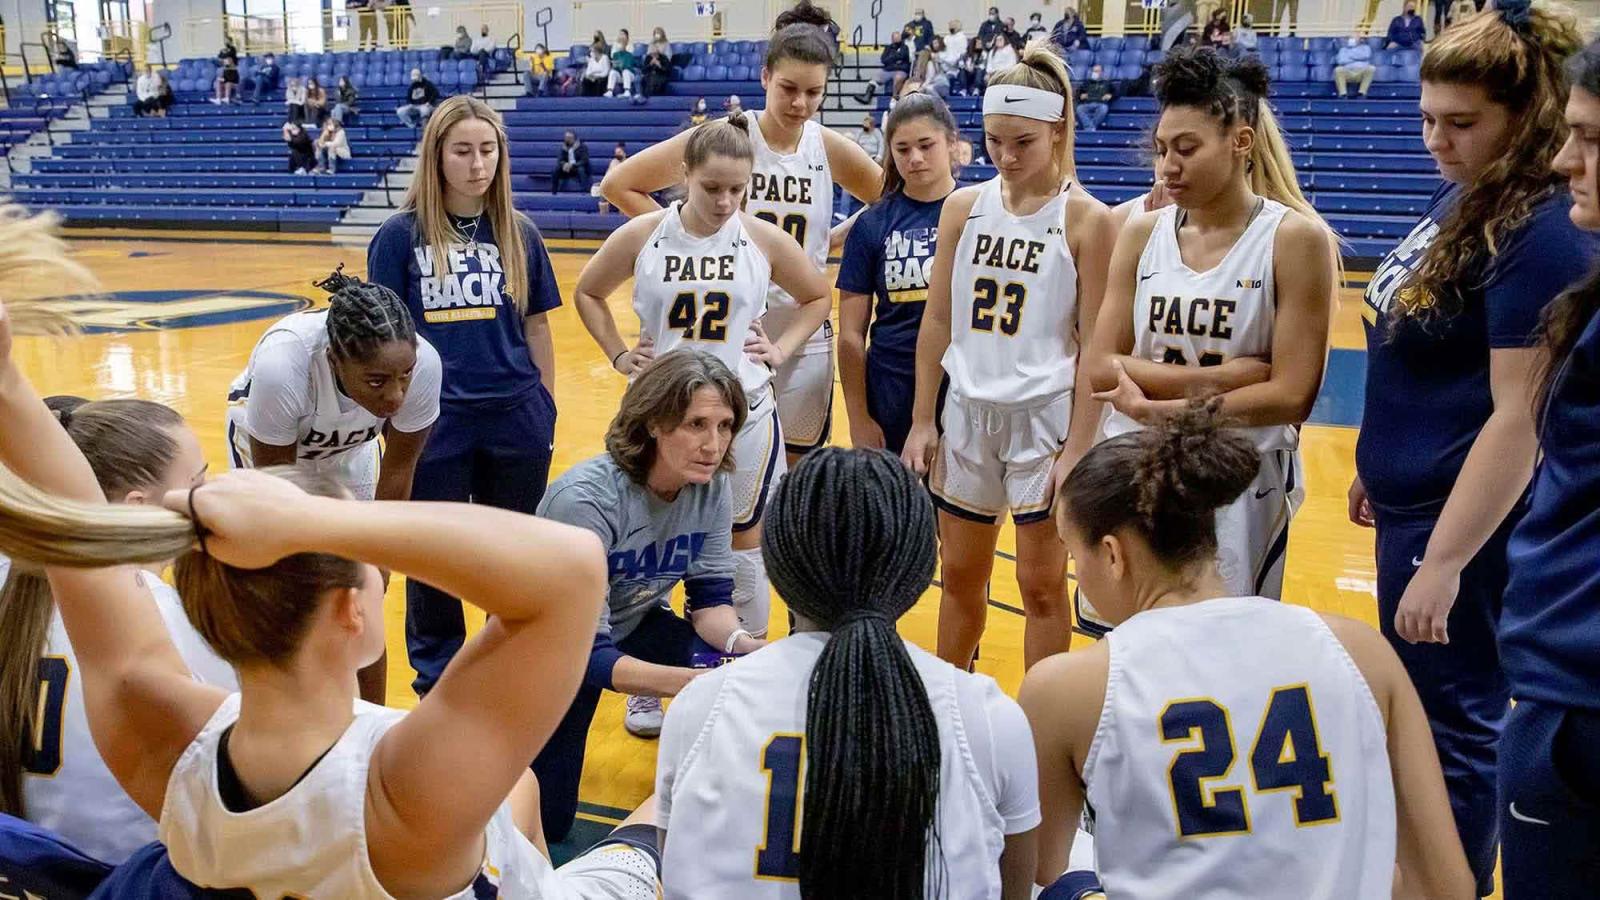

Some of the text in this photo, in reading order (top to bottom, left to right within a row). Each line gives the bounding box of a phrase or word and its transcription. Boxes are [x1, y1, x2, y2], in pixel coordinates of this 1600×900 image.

[696, 3, 715, 16] W-3
[750, 173, 812, 205] PACE
[663, 255, 735, 282] PACE
[972, 233, 1046, 274] PACE
[420, 272, 504, 310] BACK
[971, 275, 1027, 337] 23
[668, 290, 732, 343] 42
[1148, 295, 1237, 340] PACE
[1157, 681, 1341, 842] 24
